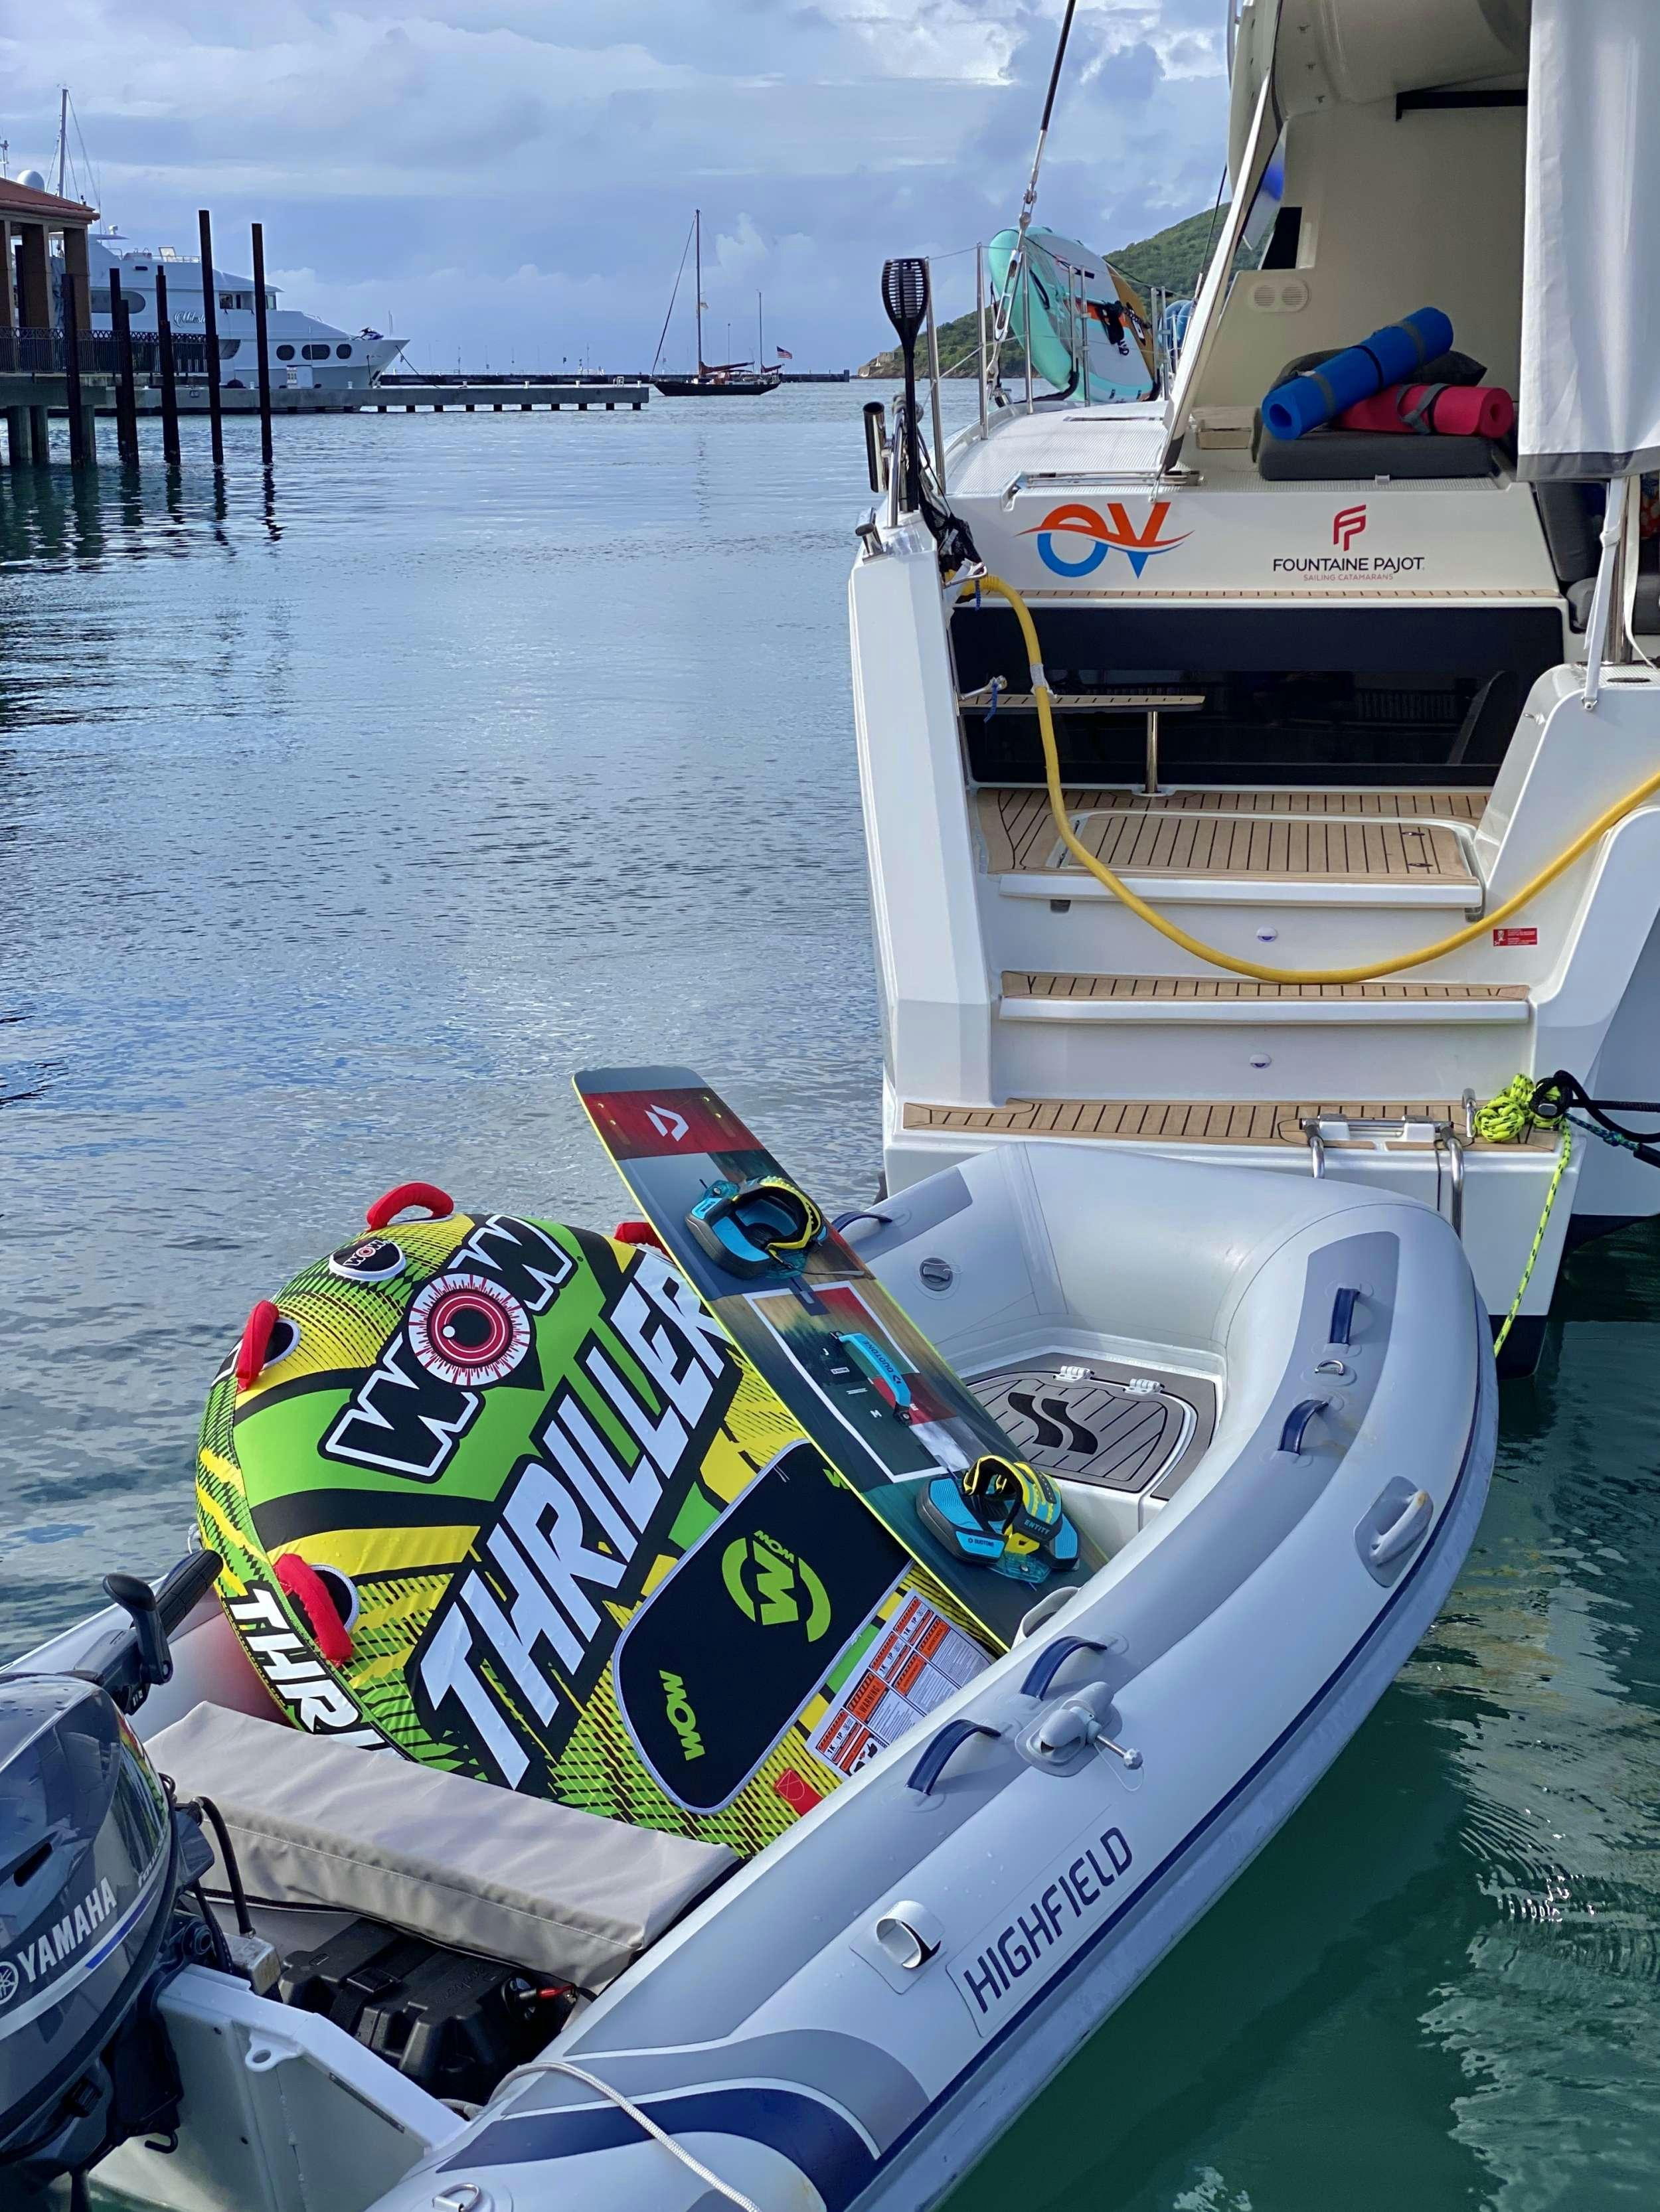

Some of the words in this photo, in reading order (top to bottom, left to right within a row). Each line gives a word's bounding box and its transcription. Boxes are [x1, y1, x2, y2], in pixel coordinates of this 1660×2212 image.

[1274, 558, 1369, 572] FOUNTAINE
[343, 1239, 386, 1266] WOW
[325, 1214, 572, 1476] WOW
[863, 1340, 894, 1374] DUOTONE
[420, 1252, 734, 1790] THRILLER
[1023, 1518, 1050, 1536] ENTITY
[230, 1588, 406, 1761] THRI
[859, 1685, 880, 1715] WARNING
[659, 1670, 706, 1761] WOW
[827, 1745, 836, 1755] 1K
[836, 1731, 843, 1741] 1P
[17, 1877, 117, 1982] YAMAHA
[963, 1827, 1132, 2014] HIGHFIELD
